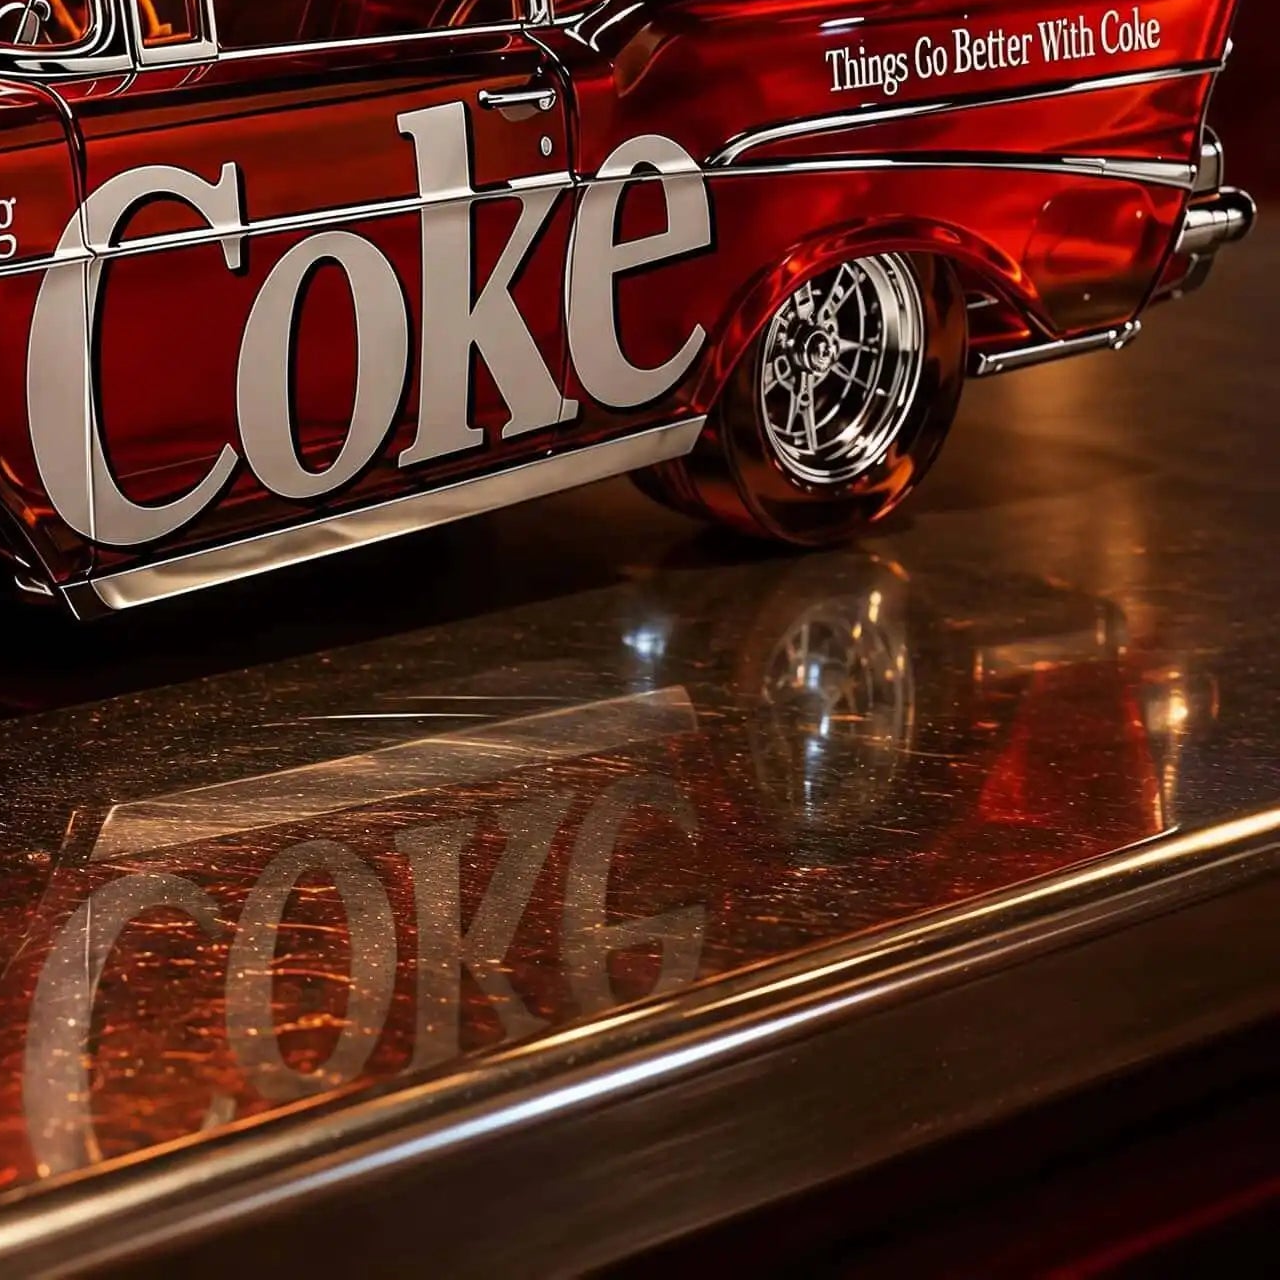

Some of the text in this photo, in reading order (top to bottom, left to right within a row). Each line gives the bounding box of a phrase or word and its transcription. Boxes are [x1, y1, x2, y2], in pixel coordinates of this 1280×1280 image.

[825, 7, 1162, 96] Things Go Better With Coke
[26, 100, 713, 547] Coke
